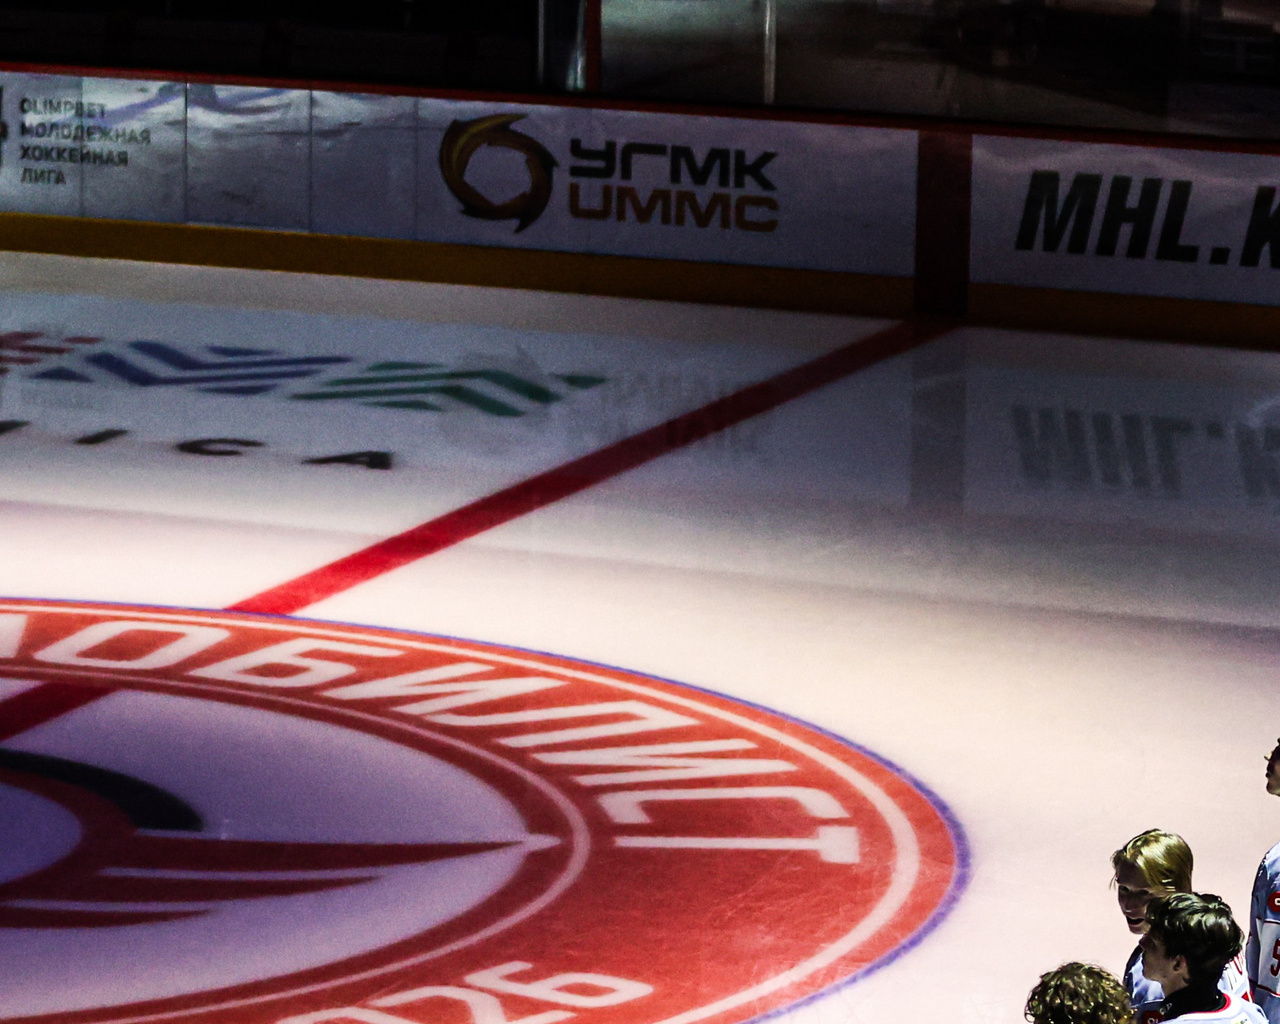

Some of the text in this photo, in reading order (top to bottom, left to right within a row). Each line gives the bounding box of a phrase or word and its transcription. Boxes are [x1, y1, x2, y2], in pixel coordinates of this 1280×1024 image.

[20, 167, 67, 185] ЛИГА
[570, 138, 778, 191] УГМК
[569, 183, 779, 233] UMMC
[0, 613, 862, 865] ОБИЛИСТ
